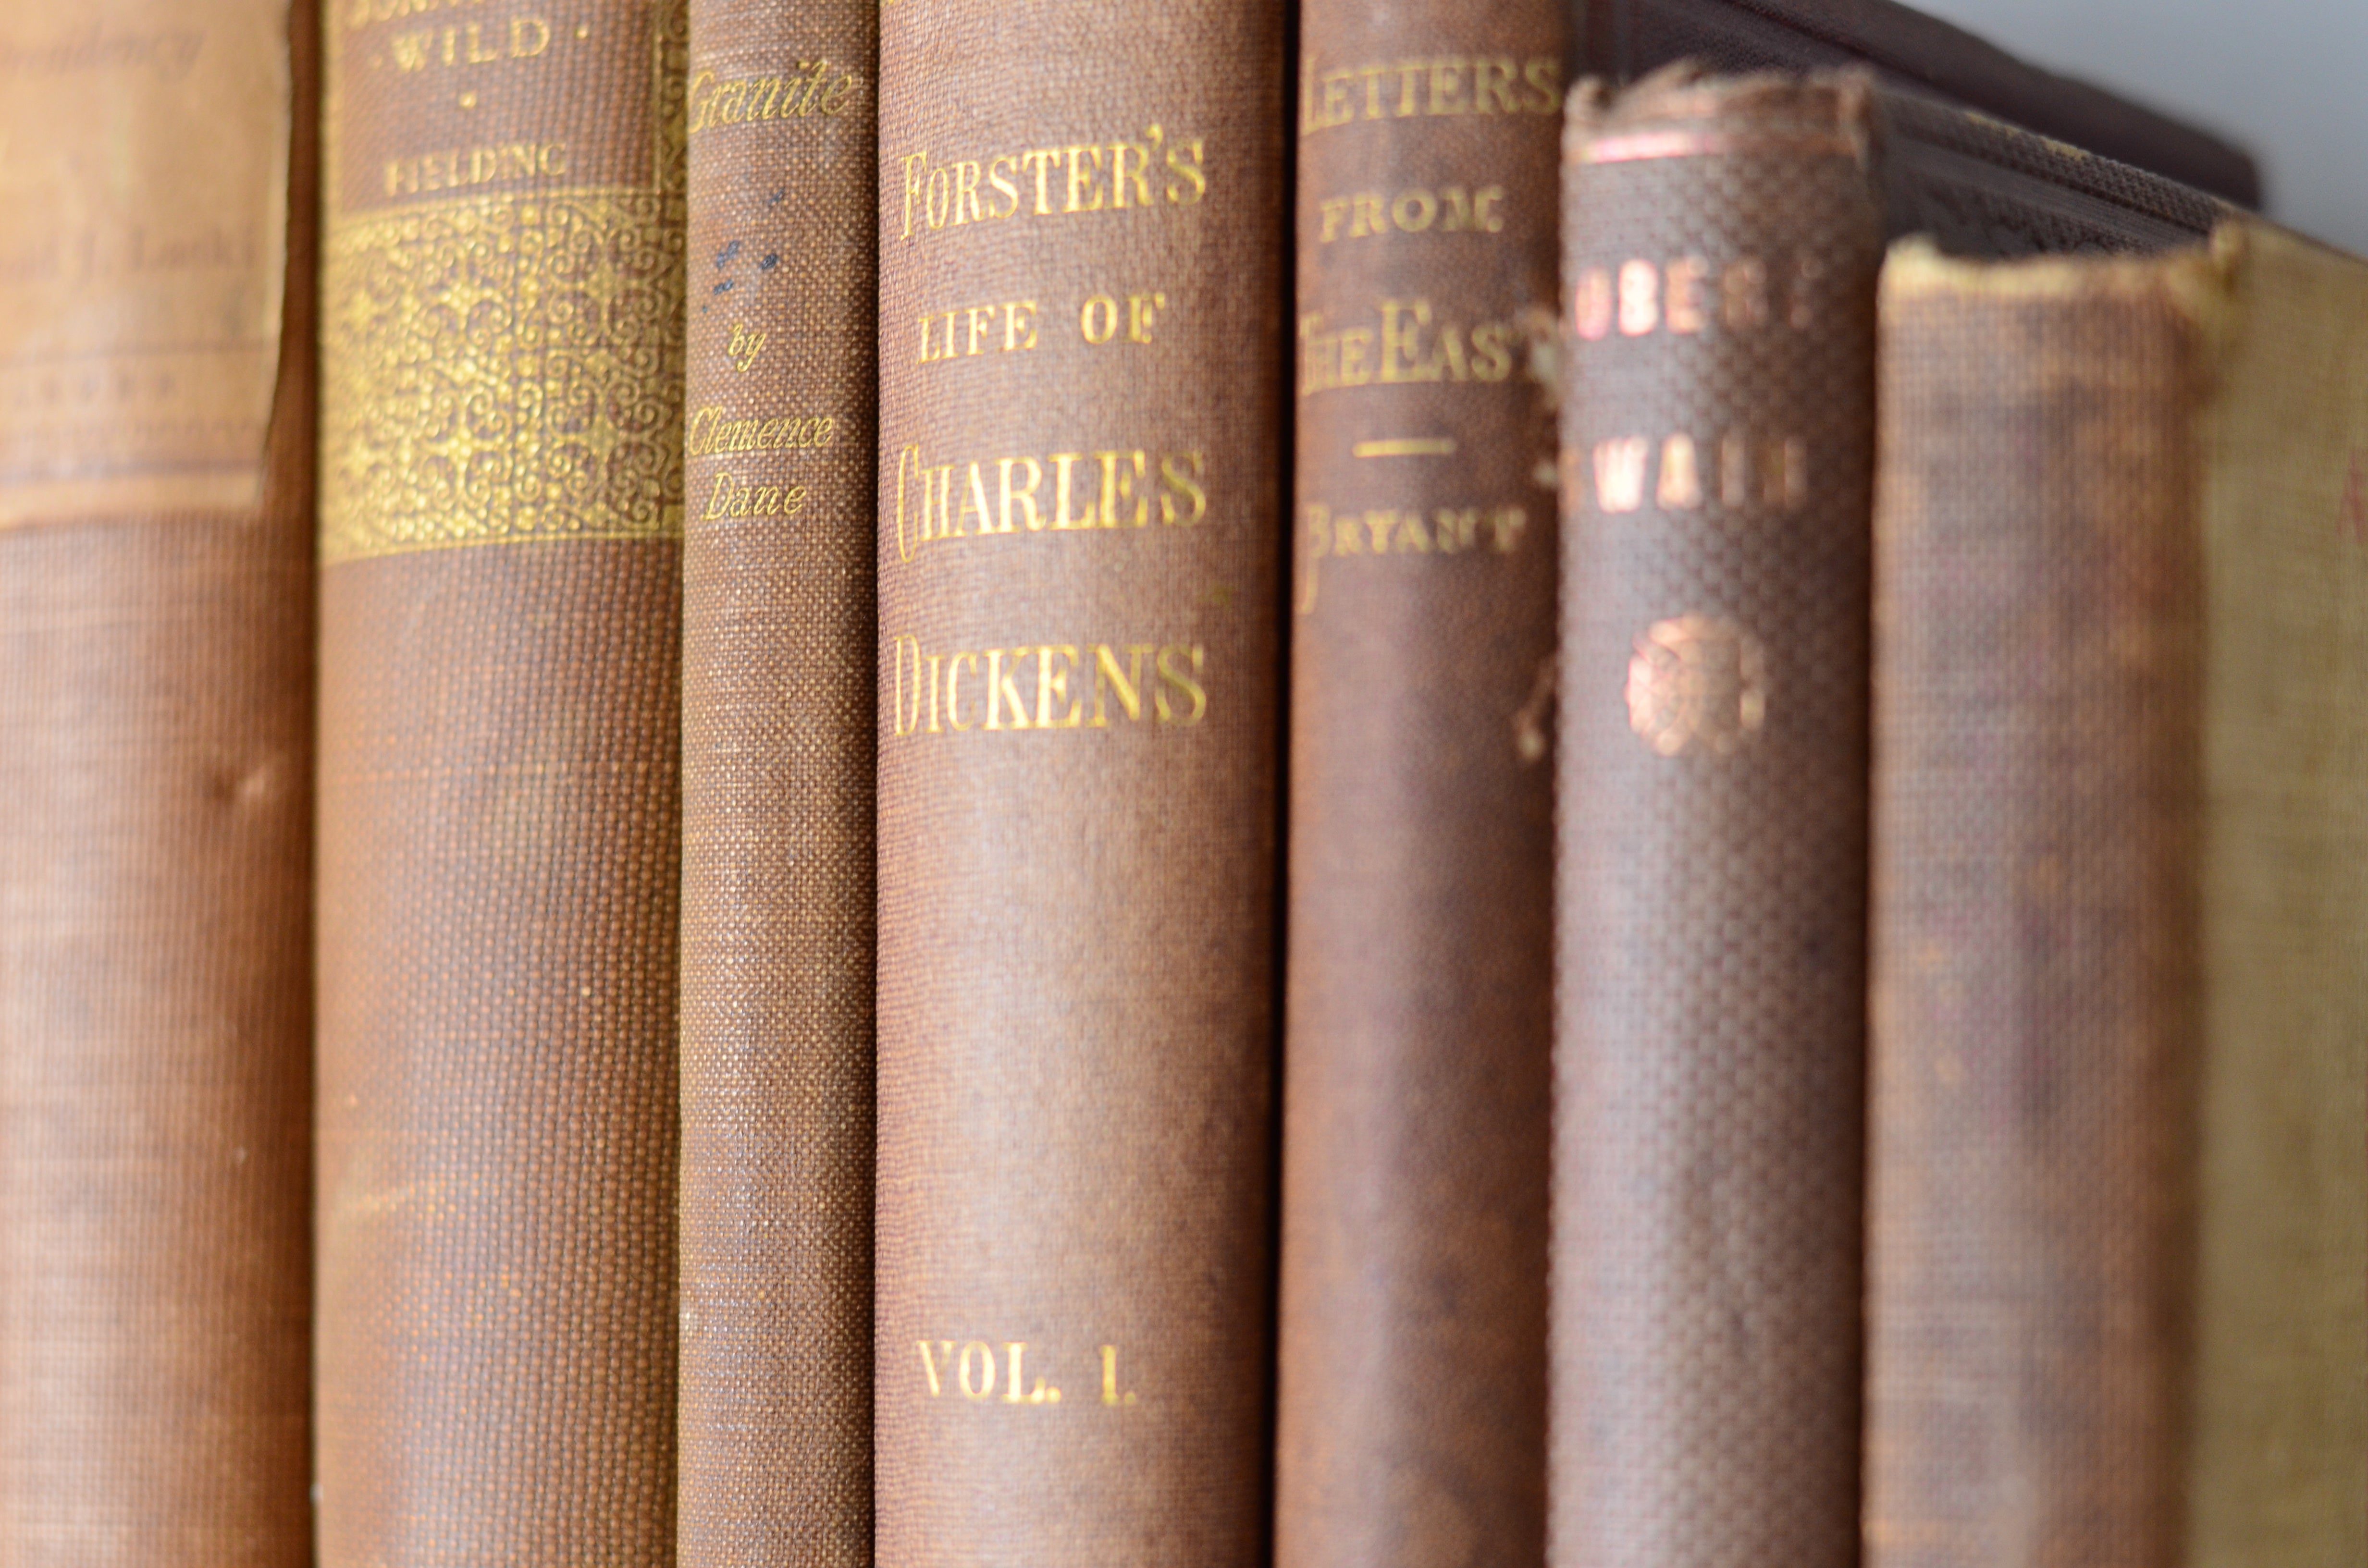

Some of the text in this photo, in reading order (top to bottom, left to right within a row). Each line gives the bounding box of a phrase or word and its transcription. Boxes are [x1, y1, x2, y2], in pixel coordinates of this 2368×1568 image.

[391, 15, 551, 72] WILD
[688, 59, 852, 134] Granite
[1300, 54, 1564, 137] LETTERS
[386, 144, 566, 196] FIELDING
[900, 123, 1206, 241] FORSTER'S
[1320, 185, 1504, 243] FROM
[728, 323, 767, 372] by
[917, 292, 1165, 366] LIFE OF
[688, 405, 833, 456] Clemence
[703, 471, 807, 521] Dane
[897, 443, 1207, 563] CHARLES
[893, 633, 1207, 737] DICKENS
[915, 1339, 1063, 1405] VOL.
